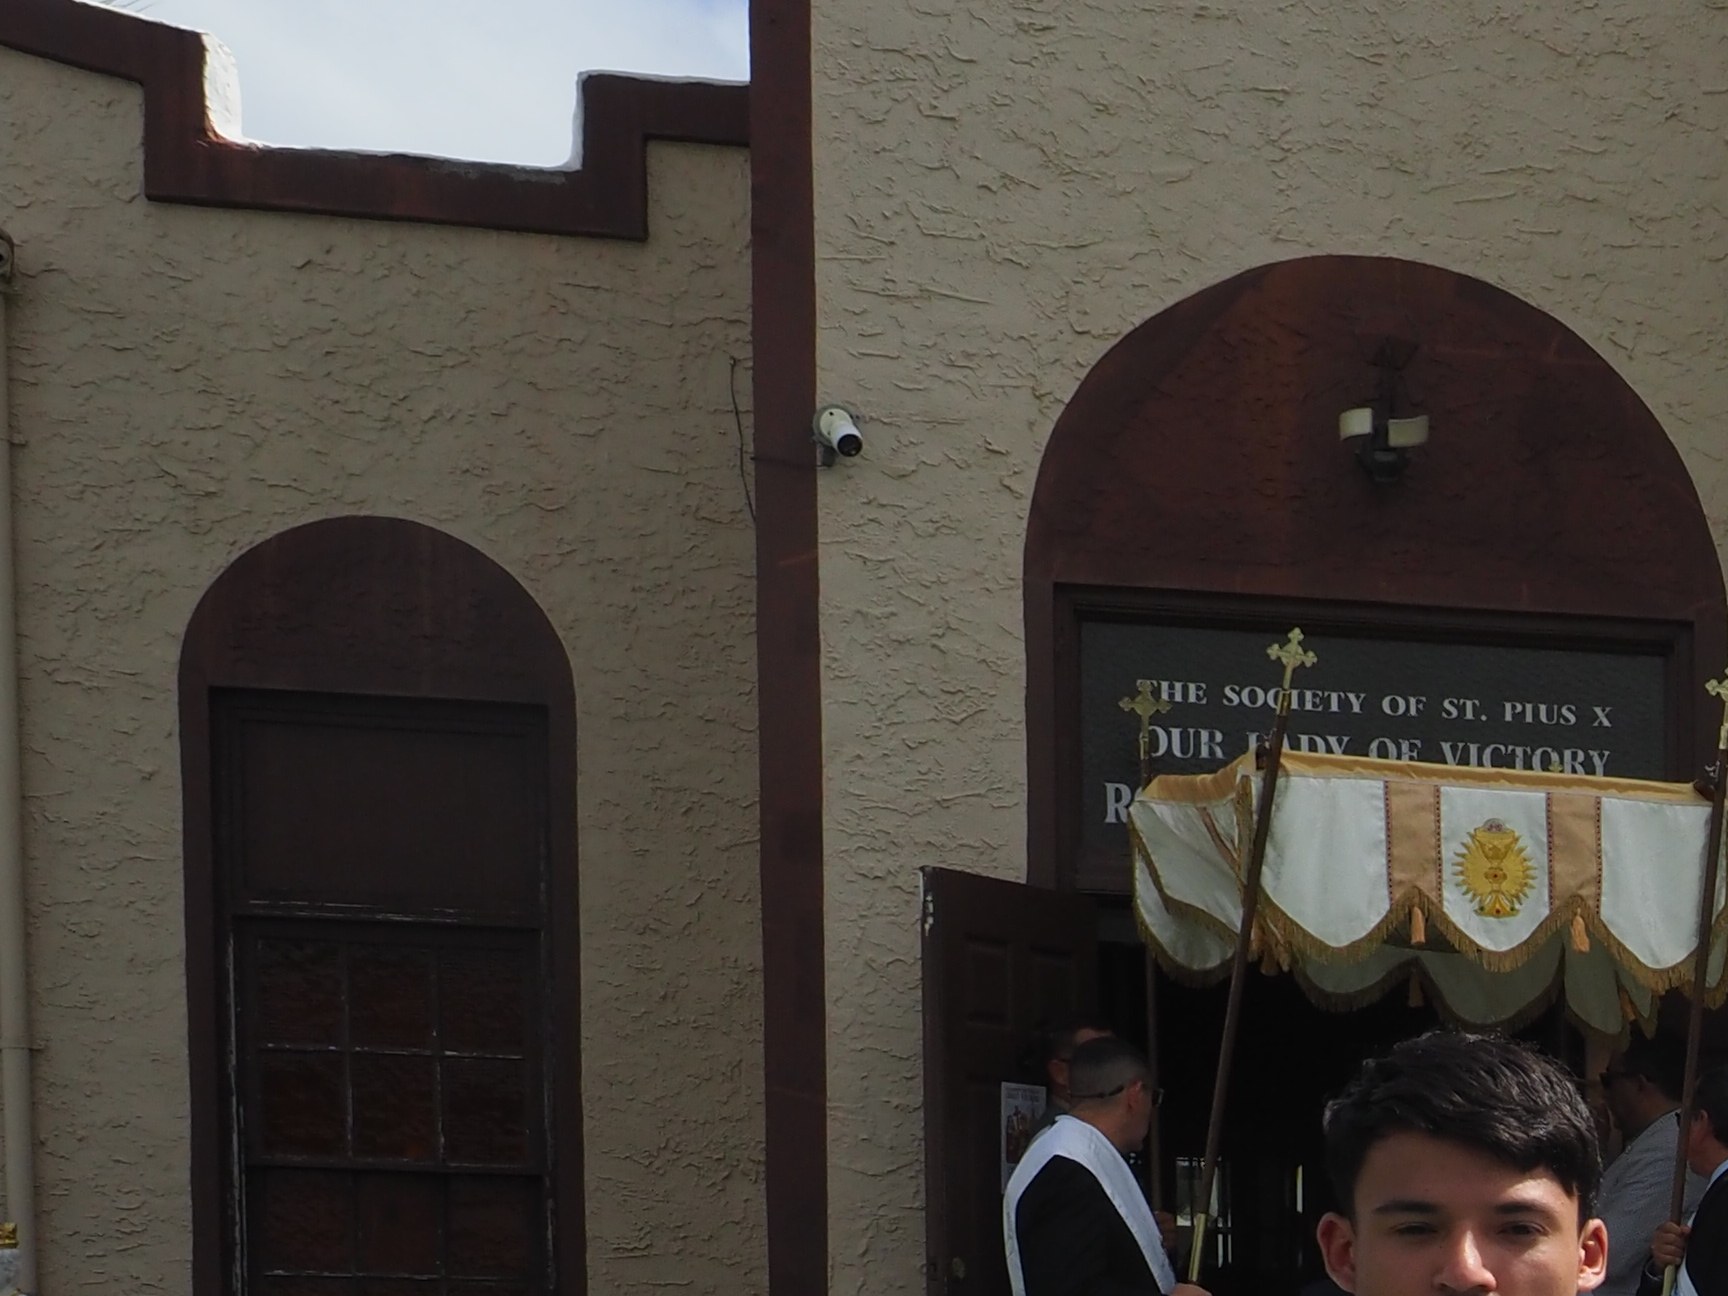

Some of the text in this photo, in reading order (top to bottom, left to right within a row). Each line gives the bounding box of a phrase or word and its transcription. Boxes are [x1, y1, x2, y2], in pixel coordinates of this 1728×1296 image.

[1222, 684, 1367, 715] SOCIETY
[1381, 694, 1427, 717] OF
[1441, 697, 1488, 722] ST.
[1503, 701, 1577, 727] PIUS
[1592, 706, 1613, 728] X
[1140, 724, 1227, 760] OUR
[1367, 736, 1422, 764] OF
[1439, 741, 1611, 777] VICTORY
